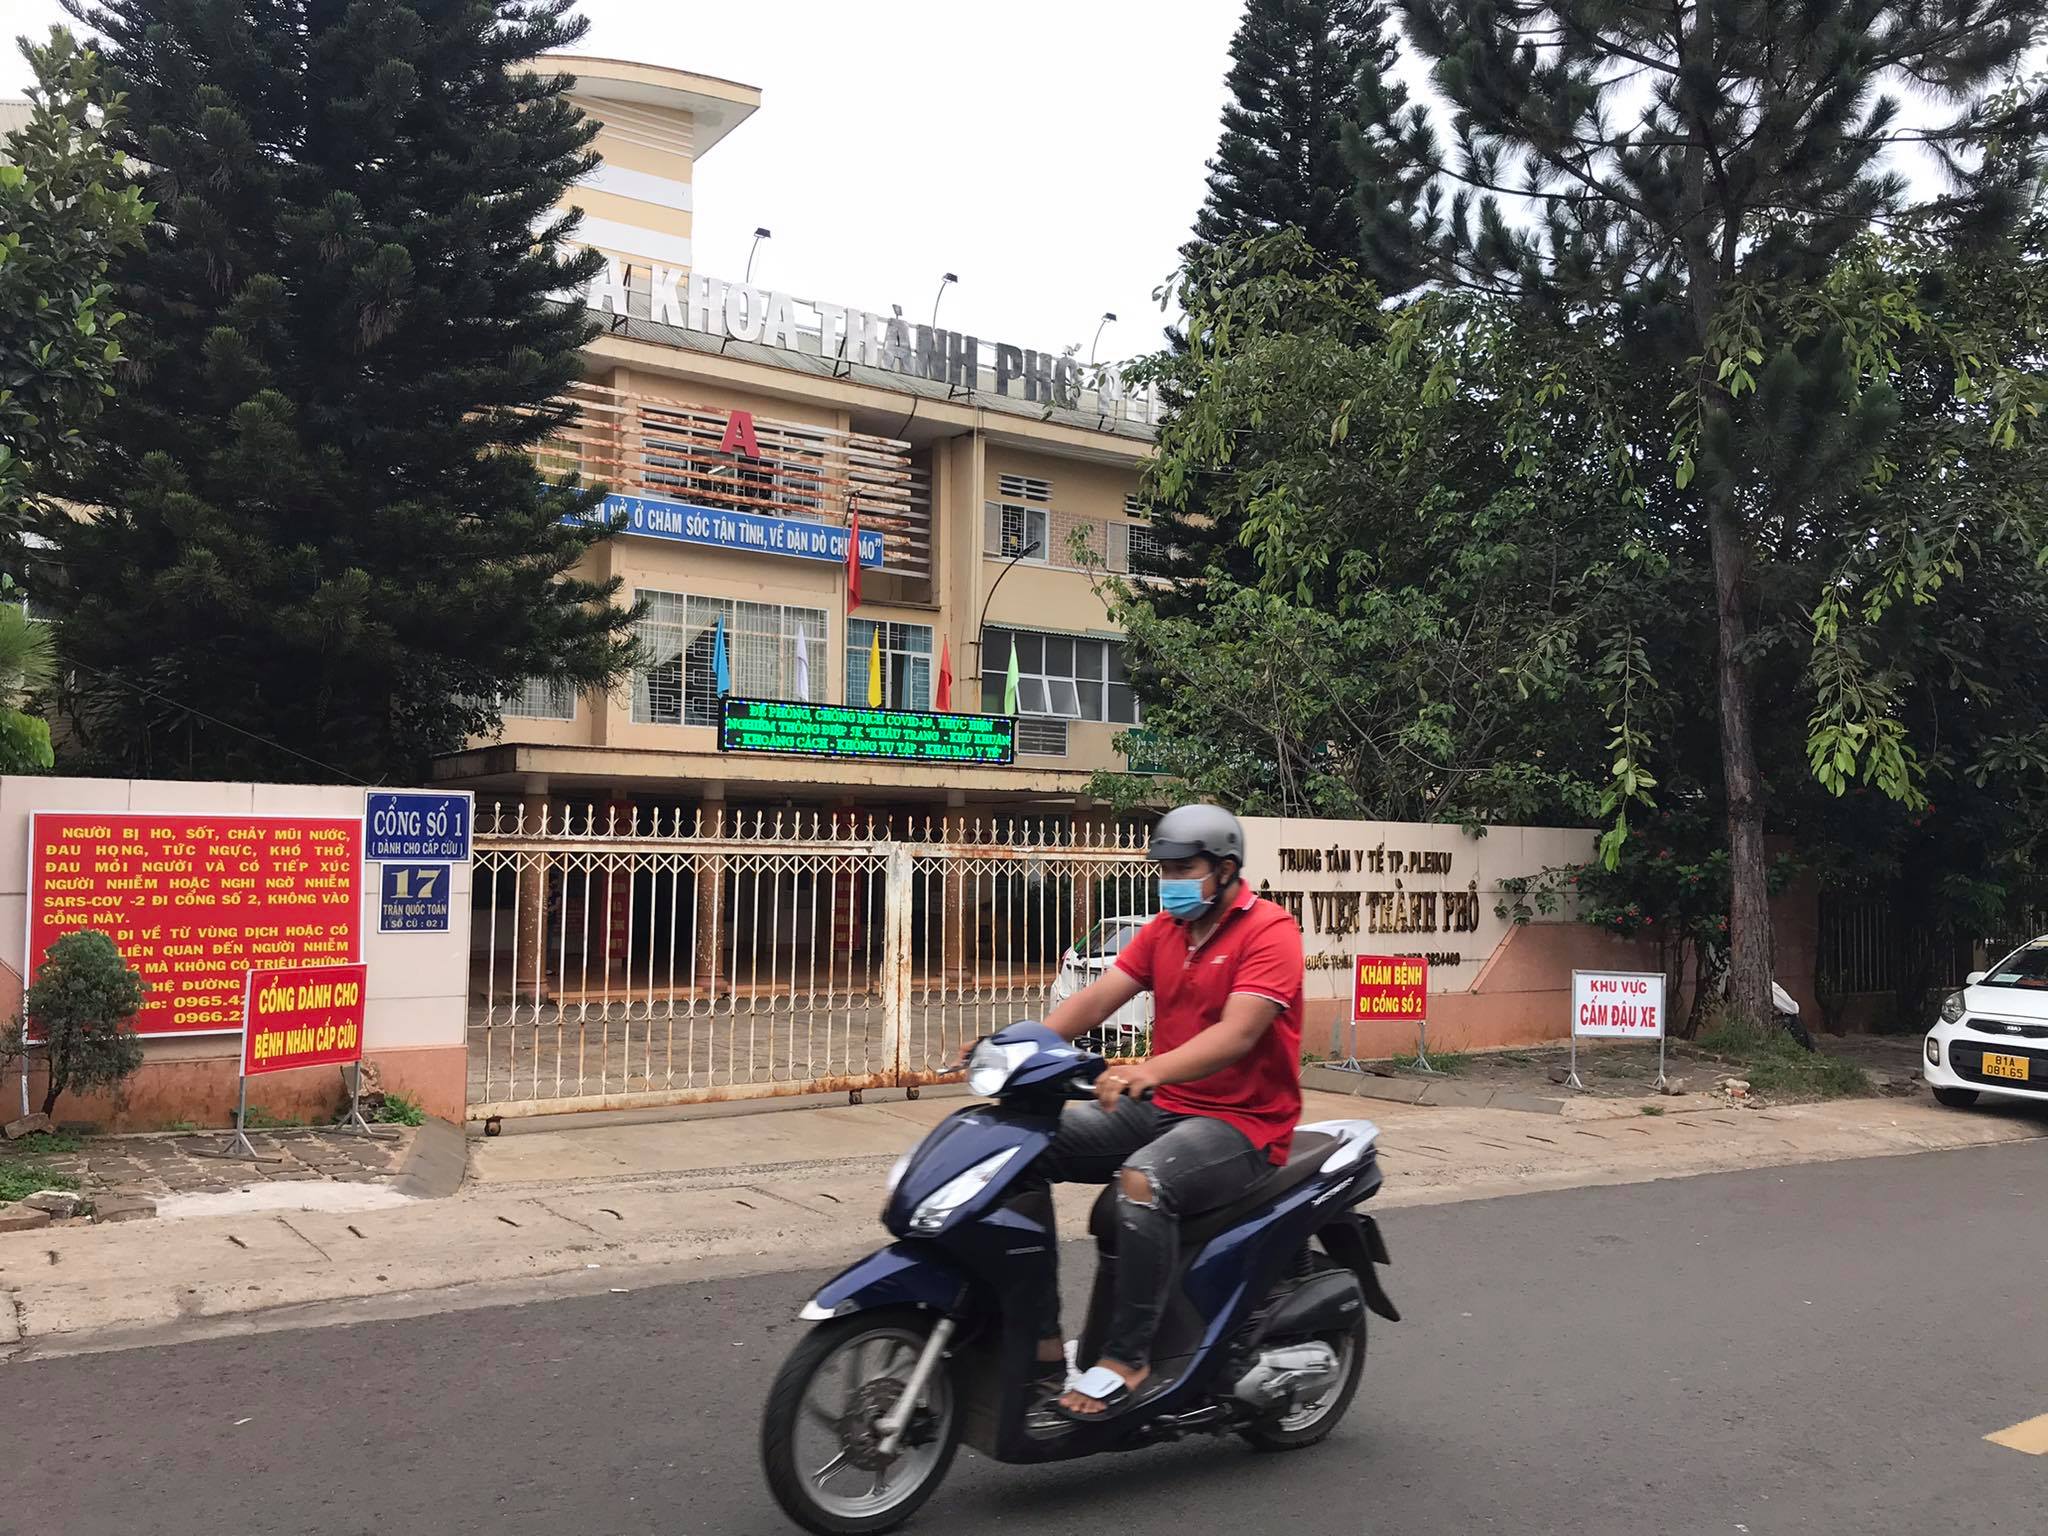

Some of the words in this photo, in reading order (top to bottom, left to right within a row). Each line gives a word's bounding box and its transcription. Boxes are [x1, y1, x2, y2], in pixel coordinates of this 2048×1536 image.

[651, 264, 800, 350] KHOA
[813, 301, 978, 388] THÀNH
[720, 409, 760, 459] A
[635, 501, 644, 528] Ở
[648, 508, 682, 534] CHĂM
[686, 512, 710, 537] SÓC
[713, 516, 736, 543] TẬN
[739, 519, 767, 549] TÌNH,
[769, 522, 784, 547] VỀ
[787, 528, 808, 554] DẶN
[811, 529, 827, 553] DÒ
[857, 712, 885, 726] DỊCH
[886, 715, 935, 730] COVID-19,
[778, 720, 820, 734] THÔNG
[903, 730, 940, 741] TRANG
[796, 735, 828, 748] CÁCH
[836, 738, 877, 751] KHÔNG
[925, 743, 951, 755] KHAI
[952, 744, 974, 756] BÁO
[975, 747, 984, 757] Y
[374, 796, 421, 836] CỔNG
[426, 800, 449, 836] SỐ
[454, 813, 462, 836] 1
[62, 826, 111, 839] NGƯỜI
[123, 828, 139, 840] BỊ
[150, 828, 176, 840] HO,
[186, 825, 219, 841] SỐT,
[228, 826, 266, 840] CHẢY
[275, 828, 301, 840] MŨI
[309, 828, 350, 842] NƯỚC,
[45, 845, 81, 856] ĐAU
[96, 845, 149, 857] HỌNG,
[163, 843, 196, 855] TỨC
[209, 845, 257, 857] NGỰC,
[270, 844, 301, 856] KHÓ
[314, 843, 350, 857] THỞ,
[403, 842, 420, 855] CHO
[422, 838, 439, 855] CẤP
[45, 862, 80, 872] ĐAU
[95, 858, 128, 872] MỎI
[142, 859, 193, 872] NGƯỜI
[206, 859, 225, 872] VÀ
[239, 859, 260, 872] CÓ
[273, 858, 309, 872] TIẾP
[320, 859, 350, 872] XÚC
[1278, 848, 1322, 873] TRUNG
[1325, 843, 1350, 873] TÂM
[1354, 850, 1364, 873] Y
[1367, 842, 1384, 873] TẾ
[45, 877, 94, 890] NGƯỜI
[106, 874, 158, 889] NHIỄM
[221, 878, 255, 889] NGHI
[266, 876, 295, 889] NGỜ
[305, 873, 349, 888] NHIỄM
[390, 868, 441, 899] 17
[44, 896, 122, 907] SARS-COV
[152, 895, 168, 906] ĐI
[175, 889, 216, 905] CỔNG
[221, 891, 242, 905] SỐ
[248, 895, 261, 906] 2,
[268, 892, 317, 905] KHÔNG
[322, 891, 350, 904] VÀO
[1365, 878, 1438, 934] THÀNH
[93, 910, 130, 924] NÀY.
[405, 900, 425, 917] QUỐC
[117, 930, 134, 941] ĐI
[142, 925, 161, 939] VỀ
[170, 926, 191, 939] TỪ
[197, 926, 238, 938] VÙNG
[245, 927, 279, 939] DỊCH
[286, 924, 323, 938] HOẶC
[330, 923, 348, 936] CÓ
[163, 945, 203, 957] QUAN
[212, 940, 243, 955] ĐẾN
[252, 940, 295, 954] NGƯỜI
[304, 937, 349, 952] NHIỄM
[145, 960, 168, 974] MÀ
[174, 959, 226, 972] KHÔNG
[230, 958, 250, 971] CÓ
[1361, 961, 1392, 985] KHÁM
[1394, 962, 1422, 991] BỆNH
[152, 979, 175, 993] HỆ
[259, 975, 295, 1014] CỔNG
[298, 979, 332, 1010] DÀNH
[334, 982, 358, 1007] CHO
[1590, 980, 1617, 993] KHU
[1621, 979, 1647, 997] VỰC
[173, 994, 245, 1008] 0965.4
[1360, 997, 1370, 1013] ĐI
[1373, 989, 1399, 1013] CỔNG
[1401, 990, 1415, 1013] SỐ
[1415, 997, 1422, 1013] 2
[173, 1010, 244, 1024] 0966.2
[1580, 995, 1607, 1026] CẤM
[1611, 1000, 1637, 1033] ĐẬU
[1640, 1006, 1656, 1027] XE
[254, 1027, 284, 1066] BỆNH
[286, 1023, 315, 1055] NHÂN
[316, 1016, 336, 1051] CẤP
[337, 1018, 357, 1049] CỨU
[1995, 1055, 2015, 1067] 81A
[1987, 1064, 2024, 1078] 081.65
